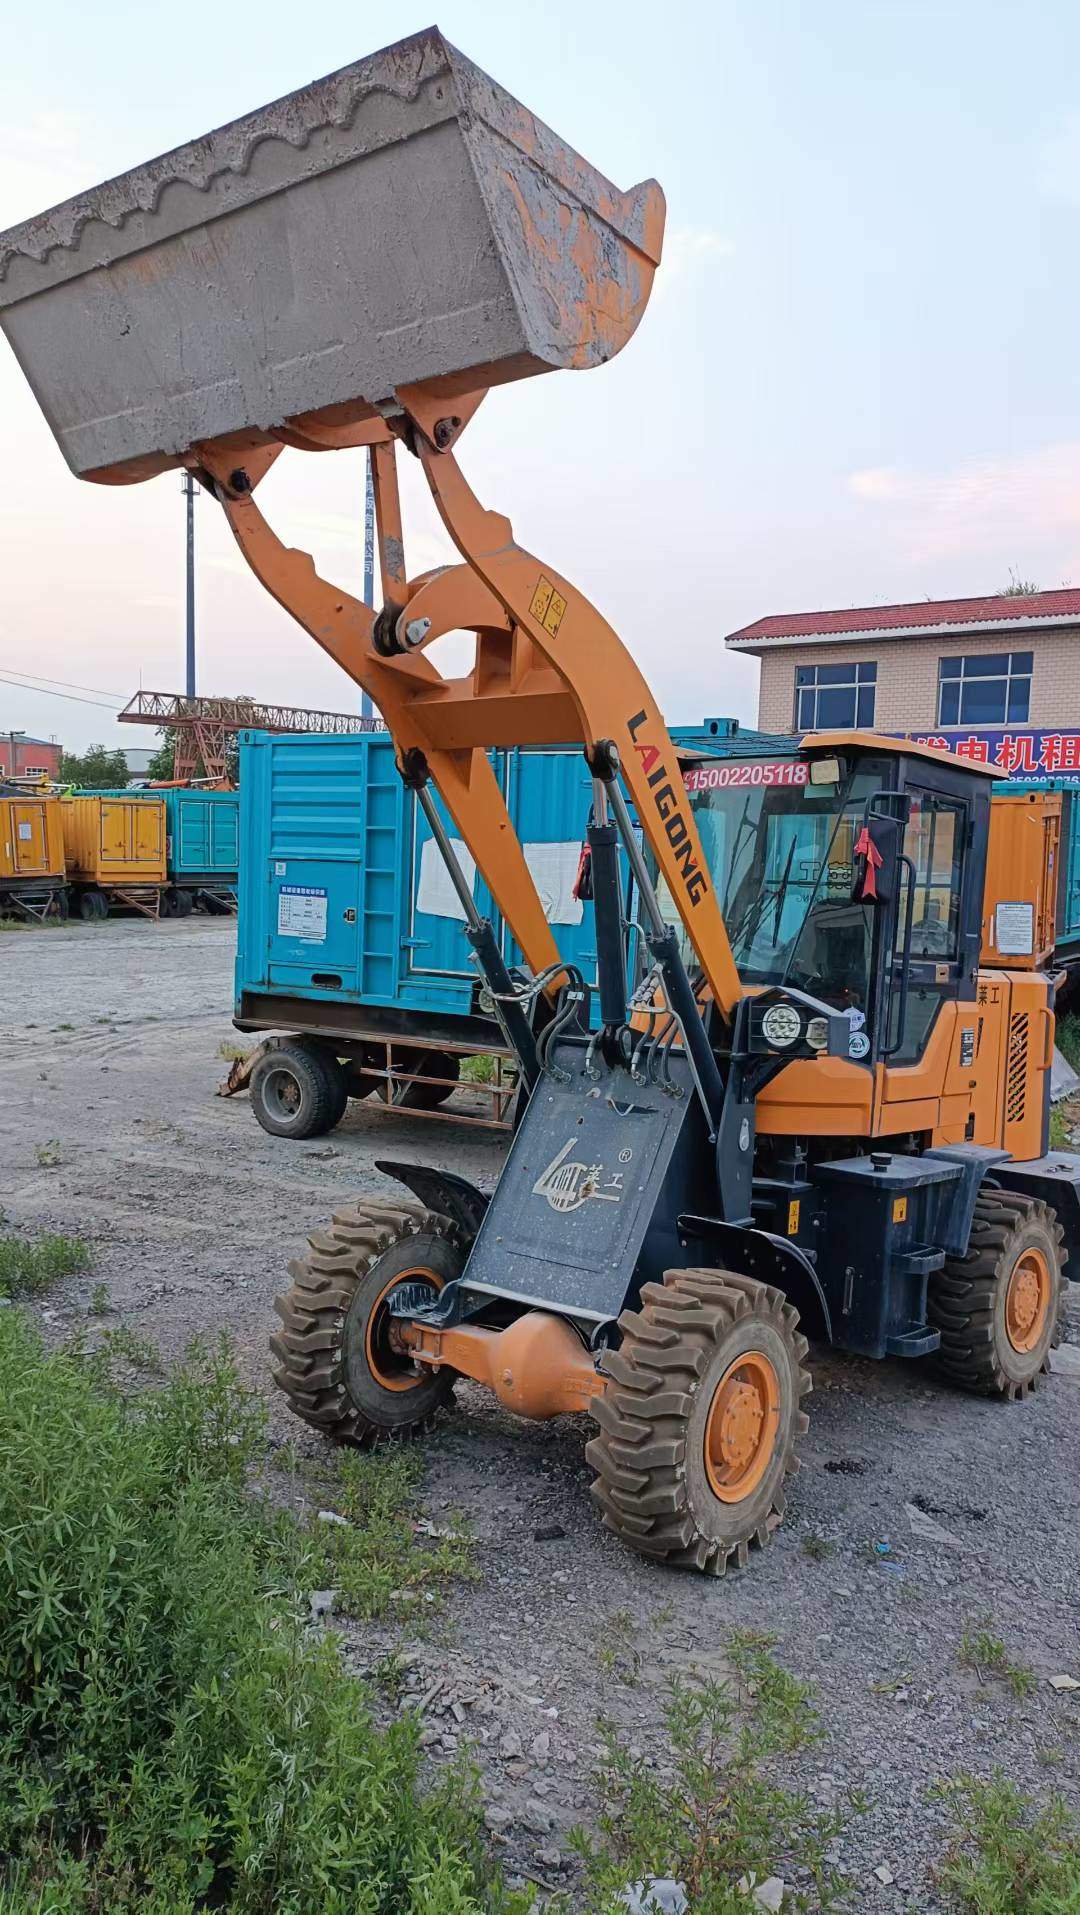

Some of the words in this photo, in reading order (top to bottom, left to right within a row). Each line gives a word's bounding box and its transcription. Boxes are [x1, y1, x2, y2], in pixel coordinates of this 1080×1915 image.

[692, 765, 807, 789] 15002205118
[627, 709, 708, 907] LAIGONG
[978, 984, 999, 1007] 莱工
